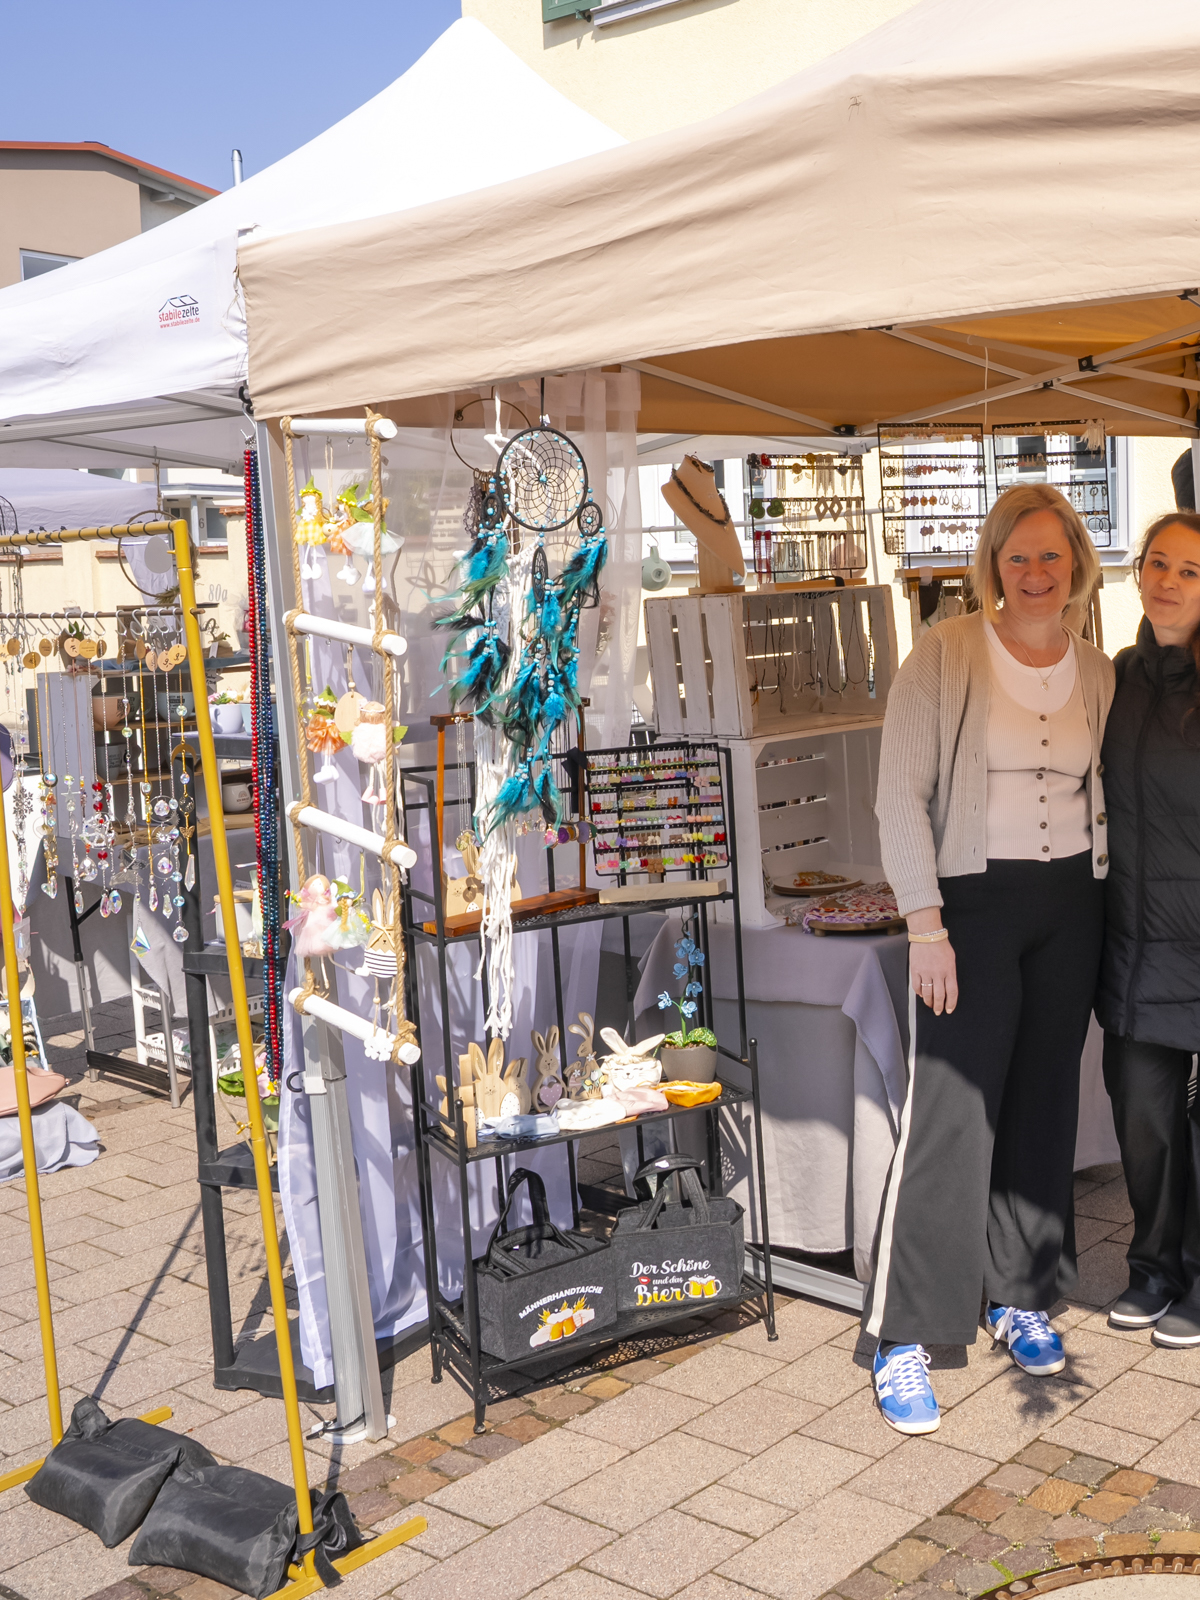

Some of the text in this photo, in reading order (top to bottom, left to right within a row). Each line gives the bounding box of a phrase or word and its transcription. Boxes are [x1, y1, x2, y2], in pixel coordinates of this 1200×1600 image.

[629, 1258, 711, 1278] Der Schöne
[653, 1276, 684, 1285] und das
[518, 1285, 603, 1319] MÄNNERHANDTASCHE
[634, 1283, 685, 1307] Bier
